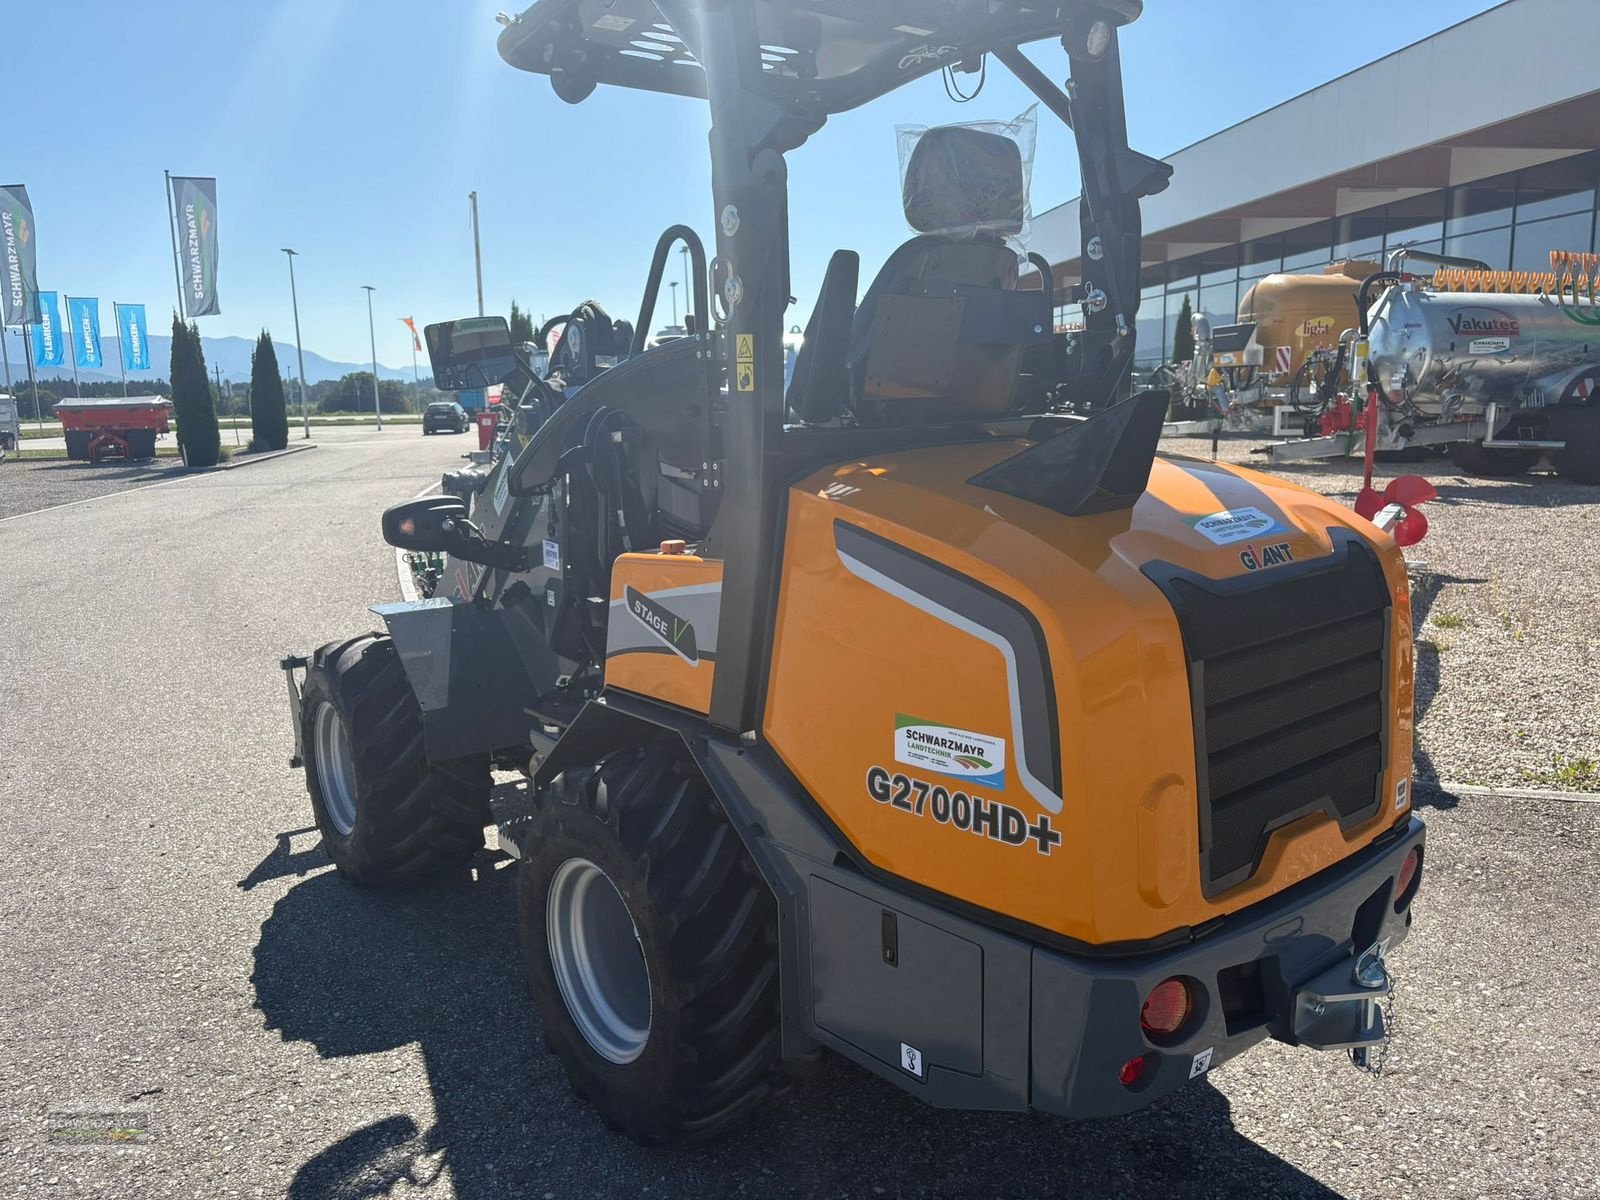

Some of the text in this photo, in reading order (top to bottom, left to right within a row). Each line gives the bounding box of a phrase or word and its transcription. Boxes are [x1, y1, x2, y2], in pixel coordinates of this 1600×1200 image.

[2, 211, 23, 307] SCHWARZMAYR
[186, 203, 204, 299] SCHWARZMAYR
[42, 313, 53, 351] LEMKEN
[82, 318, 94, 357] LEMKEN
[130, 323, 141, 358] LEMKEN
[1303, 320, 1329, 337] light
[1446, 313, 1519, 335] Vakutec
[1240, 542, 1294, 571] GIANT
[634, 600, 693, 643] STAGE V
[906, 729, 985, 757] SCHWARZMAYR
[907, 741, 952, 759] LANDTECHNIK
[866, 765, 1062, 856] G2700HD+
